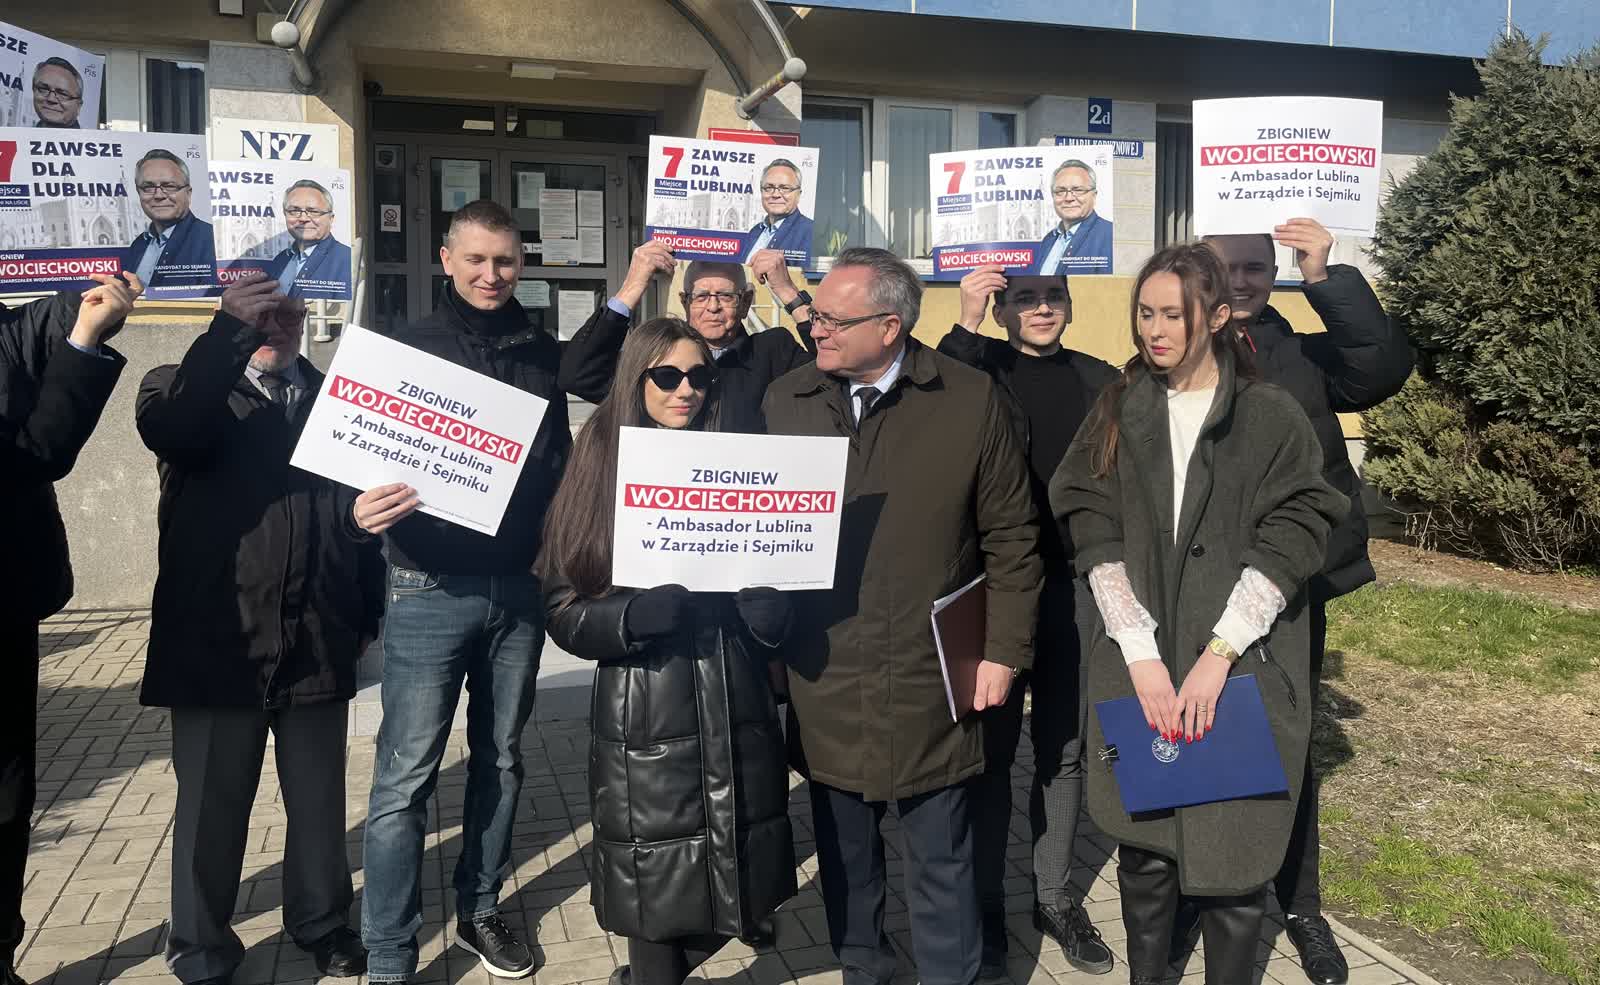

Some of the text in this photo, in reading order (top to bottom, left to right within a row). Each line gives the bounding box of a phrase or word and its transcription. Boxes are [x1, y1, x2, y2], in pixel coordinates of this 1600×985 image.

[1089, 104, 1111, 125] 2d
[1257, 127, 1331, 140] ZBIGNIEW
[30, 141, 123, 157] ZAWSZE
[240, 129, 314, 162] NFZ
[663, 147, 684, 178] 7
[692, 148, 755, 164] ZAWSZE
[1205, 145, 1373, 166] WOJCIECHOWSKI
[31, 162, 76, 176] DLA
[691, 164, 720, 177] DLA
[975, 157, 1044, 171] ZAWSZE
[944, 161, 966, 195] 7
[975, 174, 1006, 187] DLA
[1230, 168, 1314, 182] Ambasador
[1317, 169, 1360, 184] Lublina
[33, 183, 128, 197] LUBLINA
[690, 180, 754, 195] LUBLINA
[1218, 186, 1361, 202] w Zarządzie i Sejmiku
[975, 189, 1044, 203] LUBLINA
[653, 236, 738, 251] WOJCIECHOWSKI
[940, 252, 1031, 266] WOJCIECHOWSKI
[397, 380, 478, 420] ZBIGNIEW
[336, 378, 519, 461] WOJCIECHOWSKI
[351, 413, 439, 455] Ambasador
[441, 445, 493, 475] Lublina
[332, 429, 489, 494] w Zarządzie i Sejmiku
[691, 469, 778, 486] ZBIGNIEW
[629, 486, 832, 512] WOJCIECHOWSKI
[656, 516, 752, 533] Ambasador
[756, 519, 812, 533] Lublina
[642, 537, 814, 556] w Zarządzie i Sejmiku
